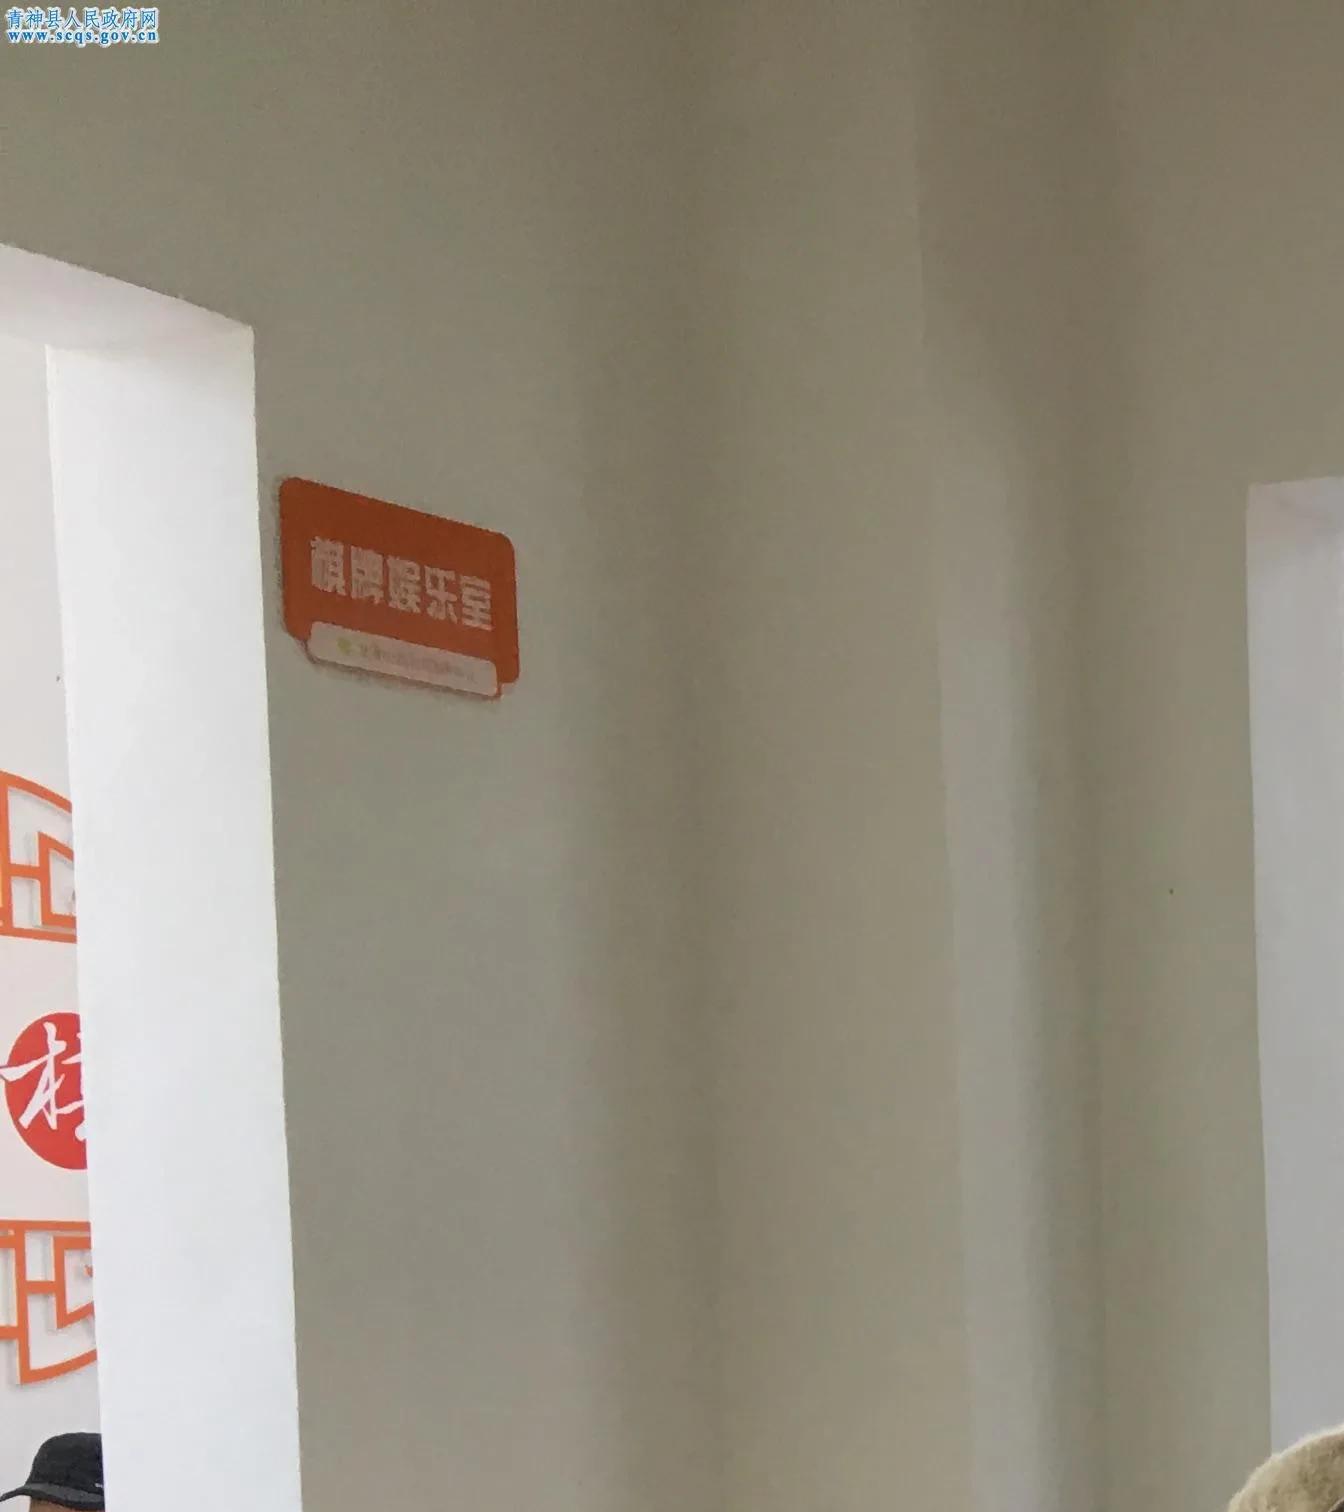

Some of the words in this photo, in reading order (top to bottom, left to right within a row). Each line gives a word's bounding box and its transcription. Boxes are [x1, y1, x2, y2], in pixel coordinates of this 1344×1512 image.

[310, 536, 493, 631] 棋牌娱乐室
